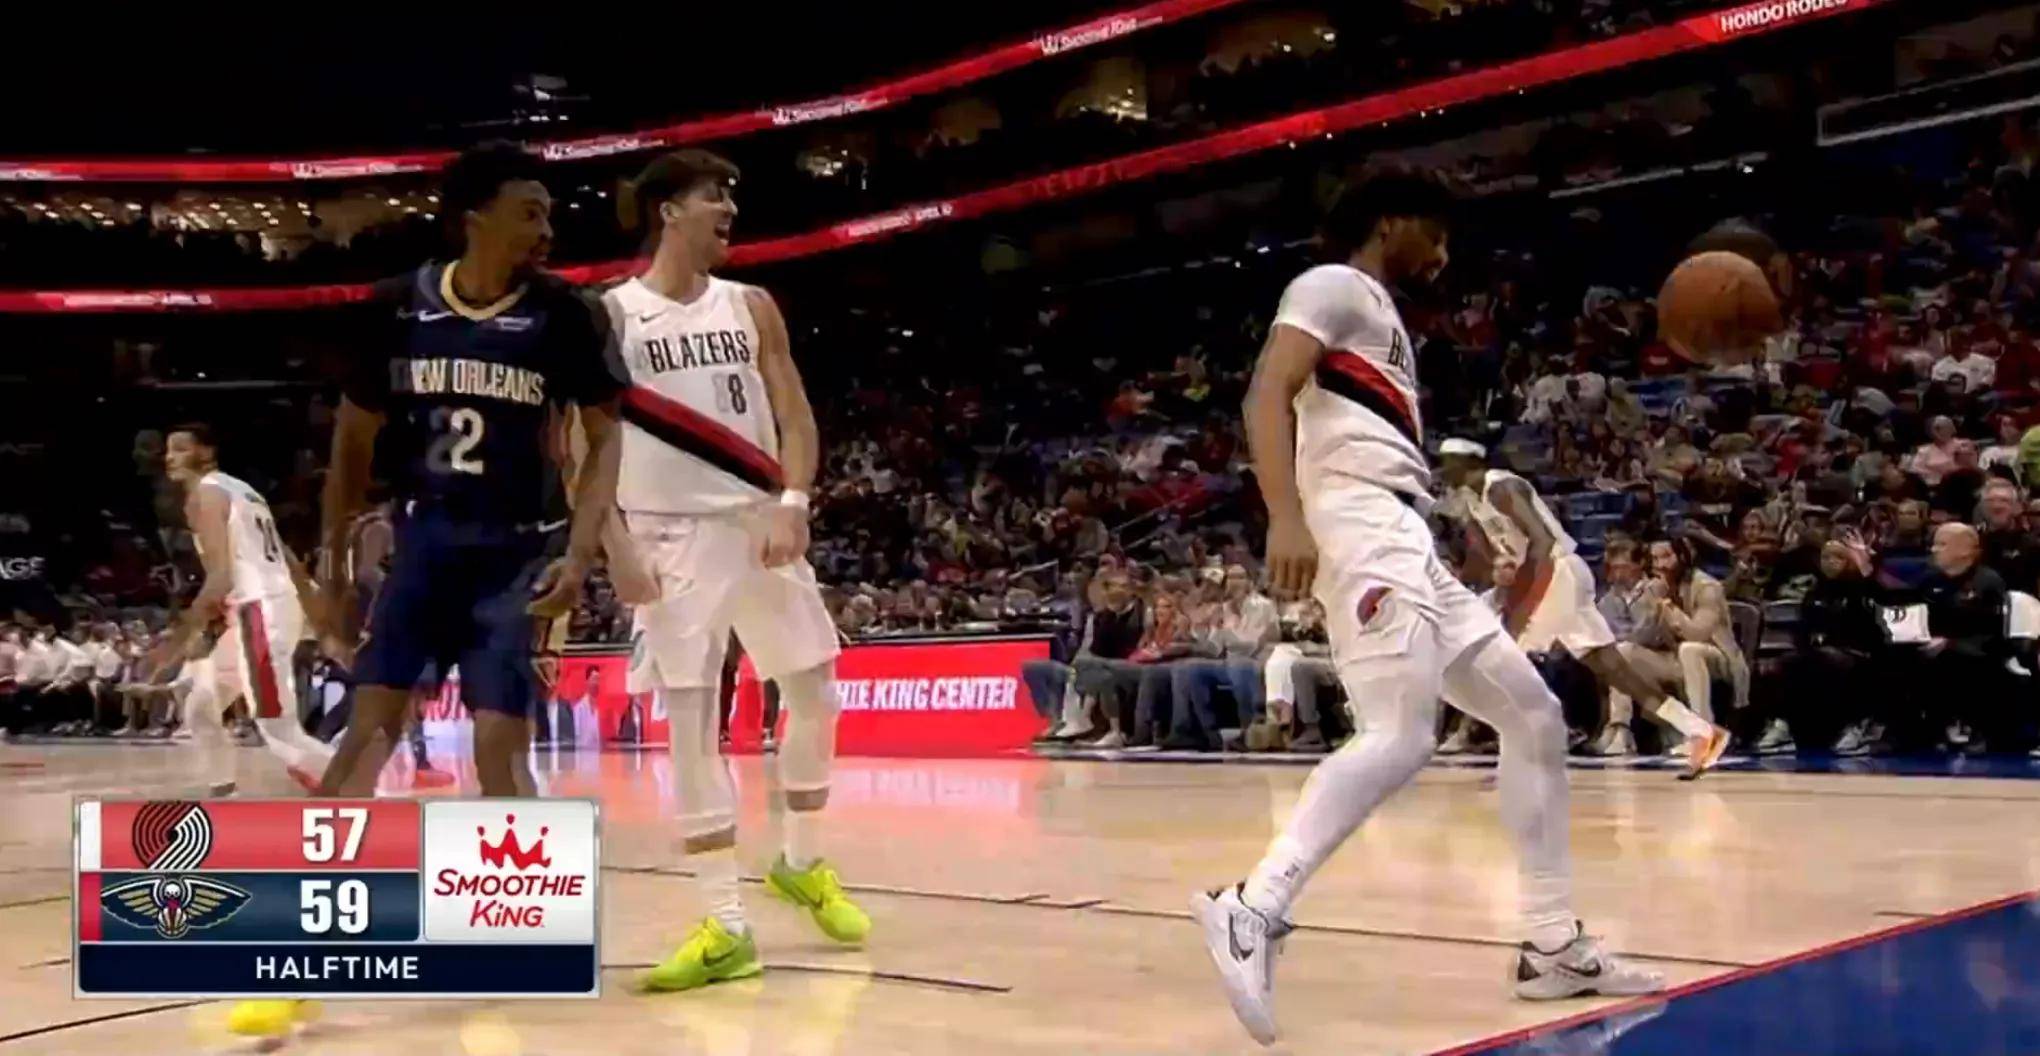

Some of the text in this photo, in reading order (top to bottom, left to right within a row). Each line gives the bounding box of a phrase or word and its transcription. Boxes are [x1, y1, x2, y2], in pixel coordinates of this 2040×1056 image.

[1720, 5, 1784, 33] HONDO
[645, 329, 751, 374] BLAZERS
[452, 358, 545, 406] ORLEANS
[872, 678, 931, 710] KING
[931, 676, 1018, 710] CENTER
